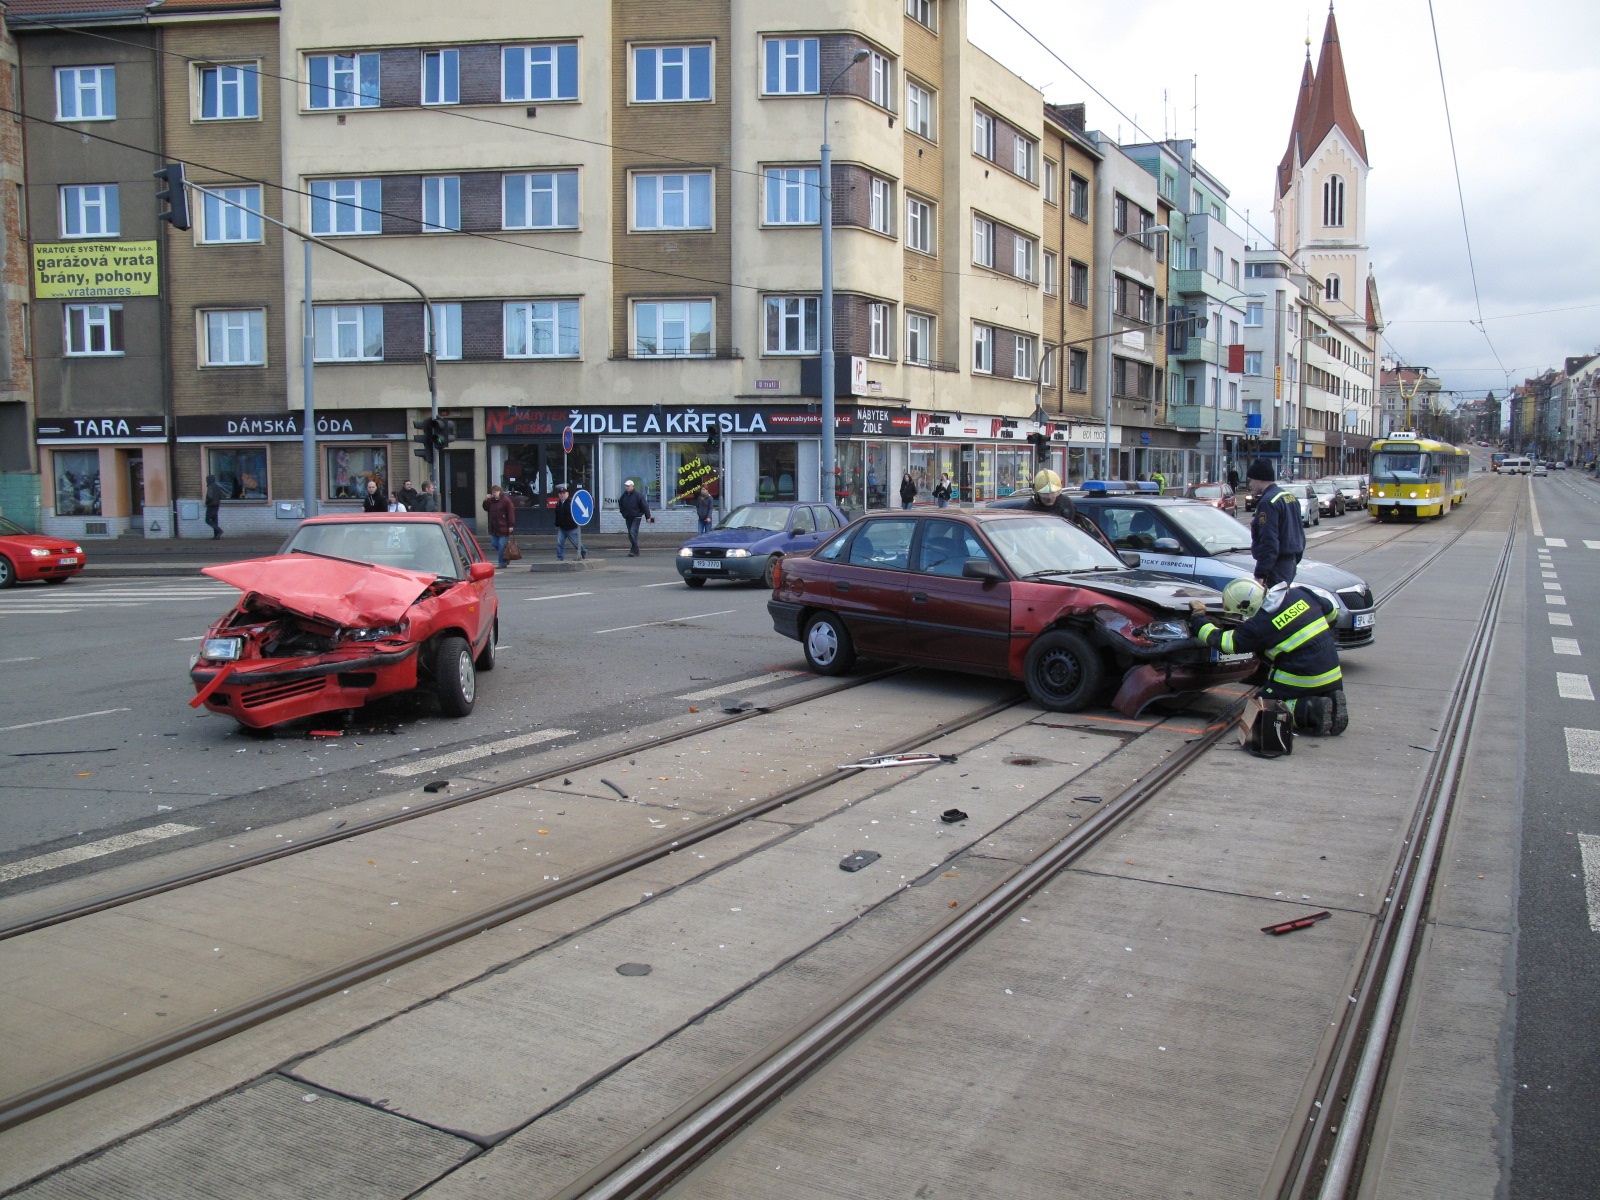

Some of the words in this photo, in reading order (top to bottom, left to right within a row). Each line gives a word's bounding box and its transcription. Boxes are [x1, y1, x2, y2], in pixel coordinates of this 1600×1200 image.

[36, 246, 76, 254] VRATOVÉ
[36, 254, 108, 271] garážová
[113, 254, 155, 266] vrata
[40, 271, 90, 286] brány,
[95, 270, 152, 285] pohony
[568, 409, 637, 433] ŽIDLE
[643, 413, 661, 433] A
[666, 408, 767, 433] KŘESLA
[857, 407, 889, 421] NÁBYTEK
[74, 419, 130, 436] TARA
[227, 417, 297, 433] DÁMSKÁ
[317, 416, 353, 432] ÓDA
[515, 423, 552, 433] PEŠKA
[862, 419, 883, 433] ŽIDLE
[678, 457, 701, 474] nový
[679, 465, 712, 486] e-shop
